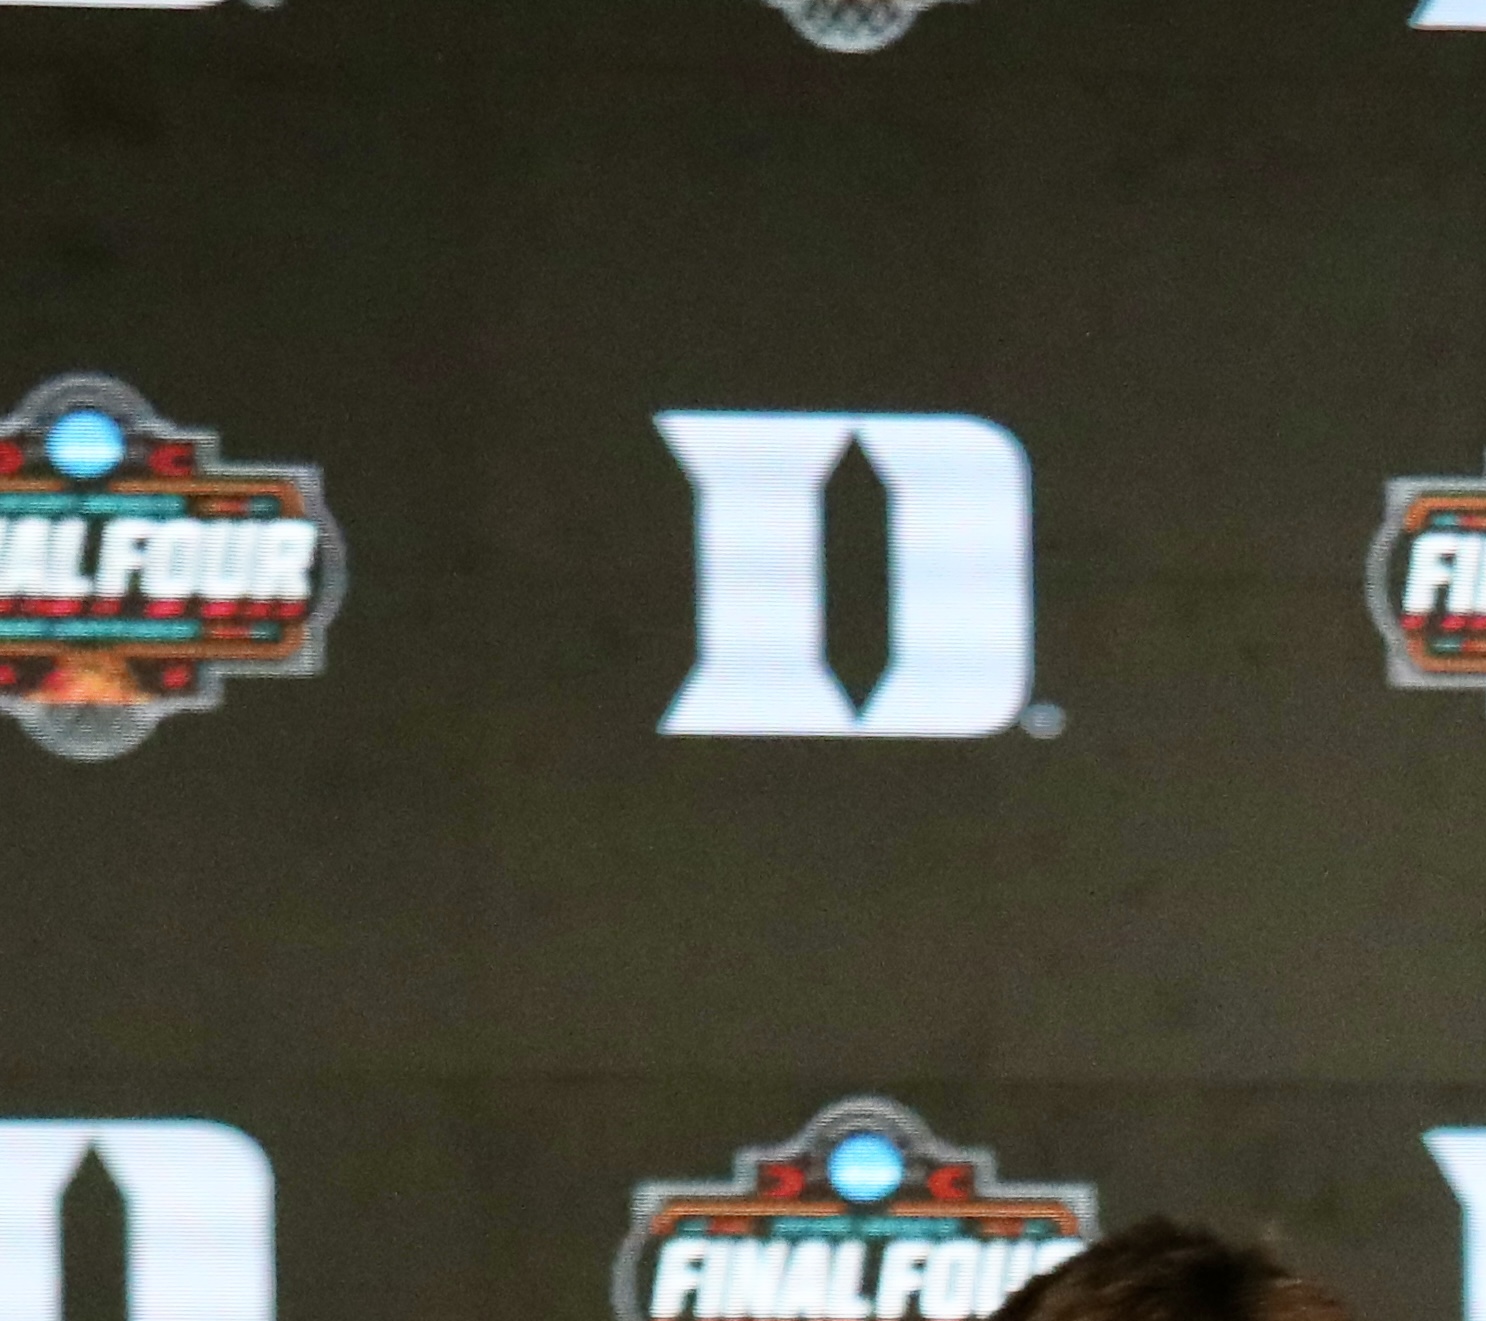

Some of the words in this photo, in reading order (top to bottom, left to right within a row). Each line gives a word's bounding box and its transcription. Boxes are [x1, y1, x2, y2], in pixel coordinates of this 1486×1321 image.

[96, 518, 318, 602] FOUR
[654, 411, 1033, 739] D
[650, 1237, 873, 1321] FINAL
